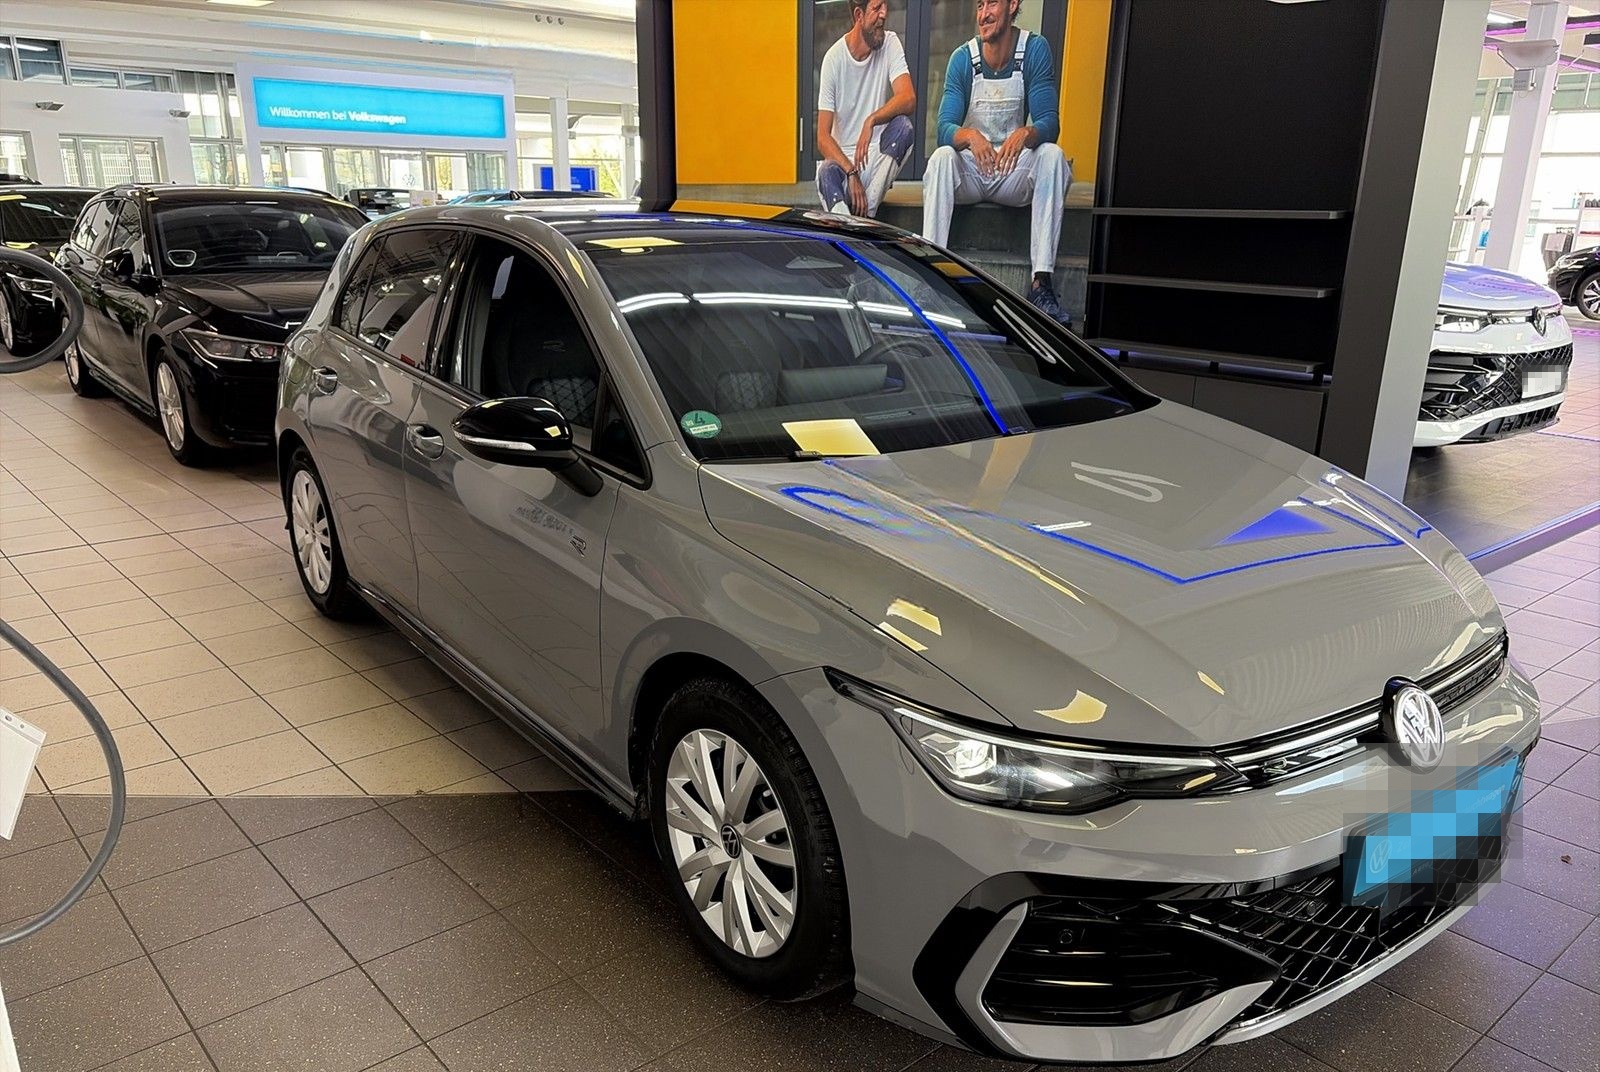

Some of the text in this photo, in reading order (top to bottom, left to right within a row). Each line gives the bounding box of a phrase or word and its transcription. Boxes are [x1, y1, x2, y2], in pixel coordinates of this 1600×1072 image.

[269, 107, 407, 125] Willkommen bei Volkswagen
[695, 412, 705, 424] 4
